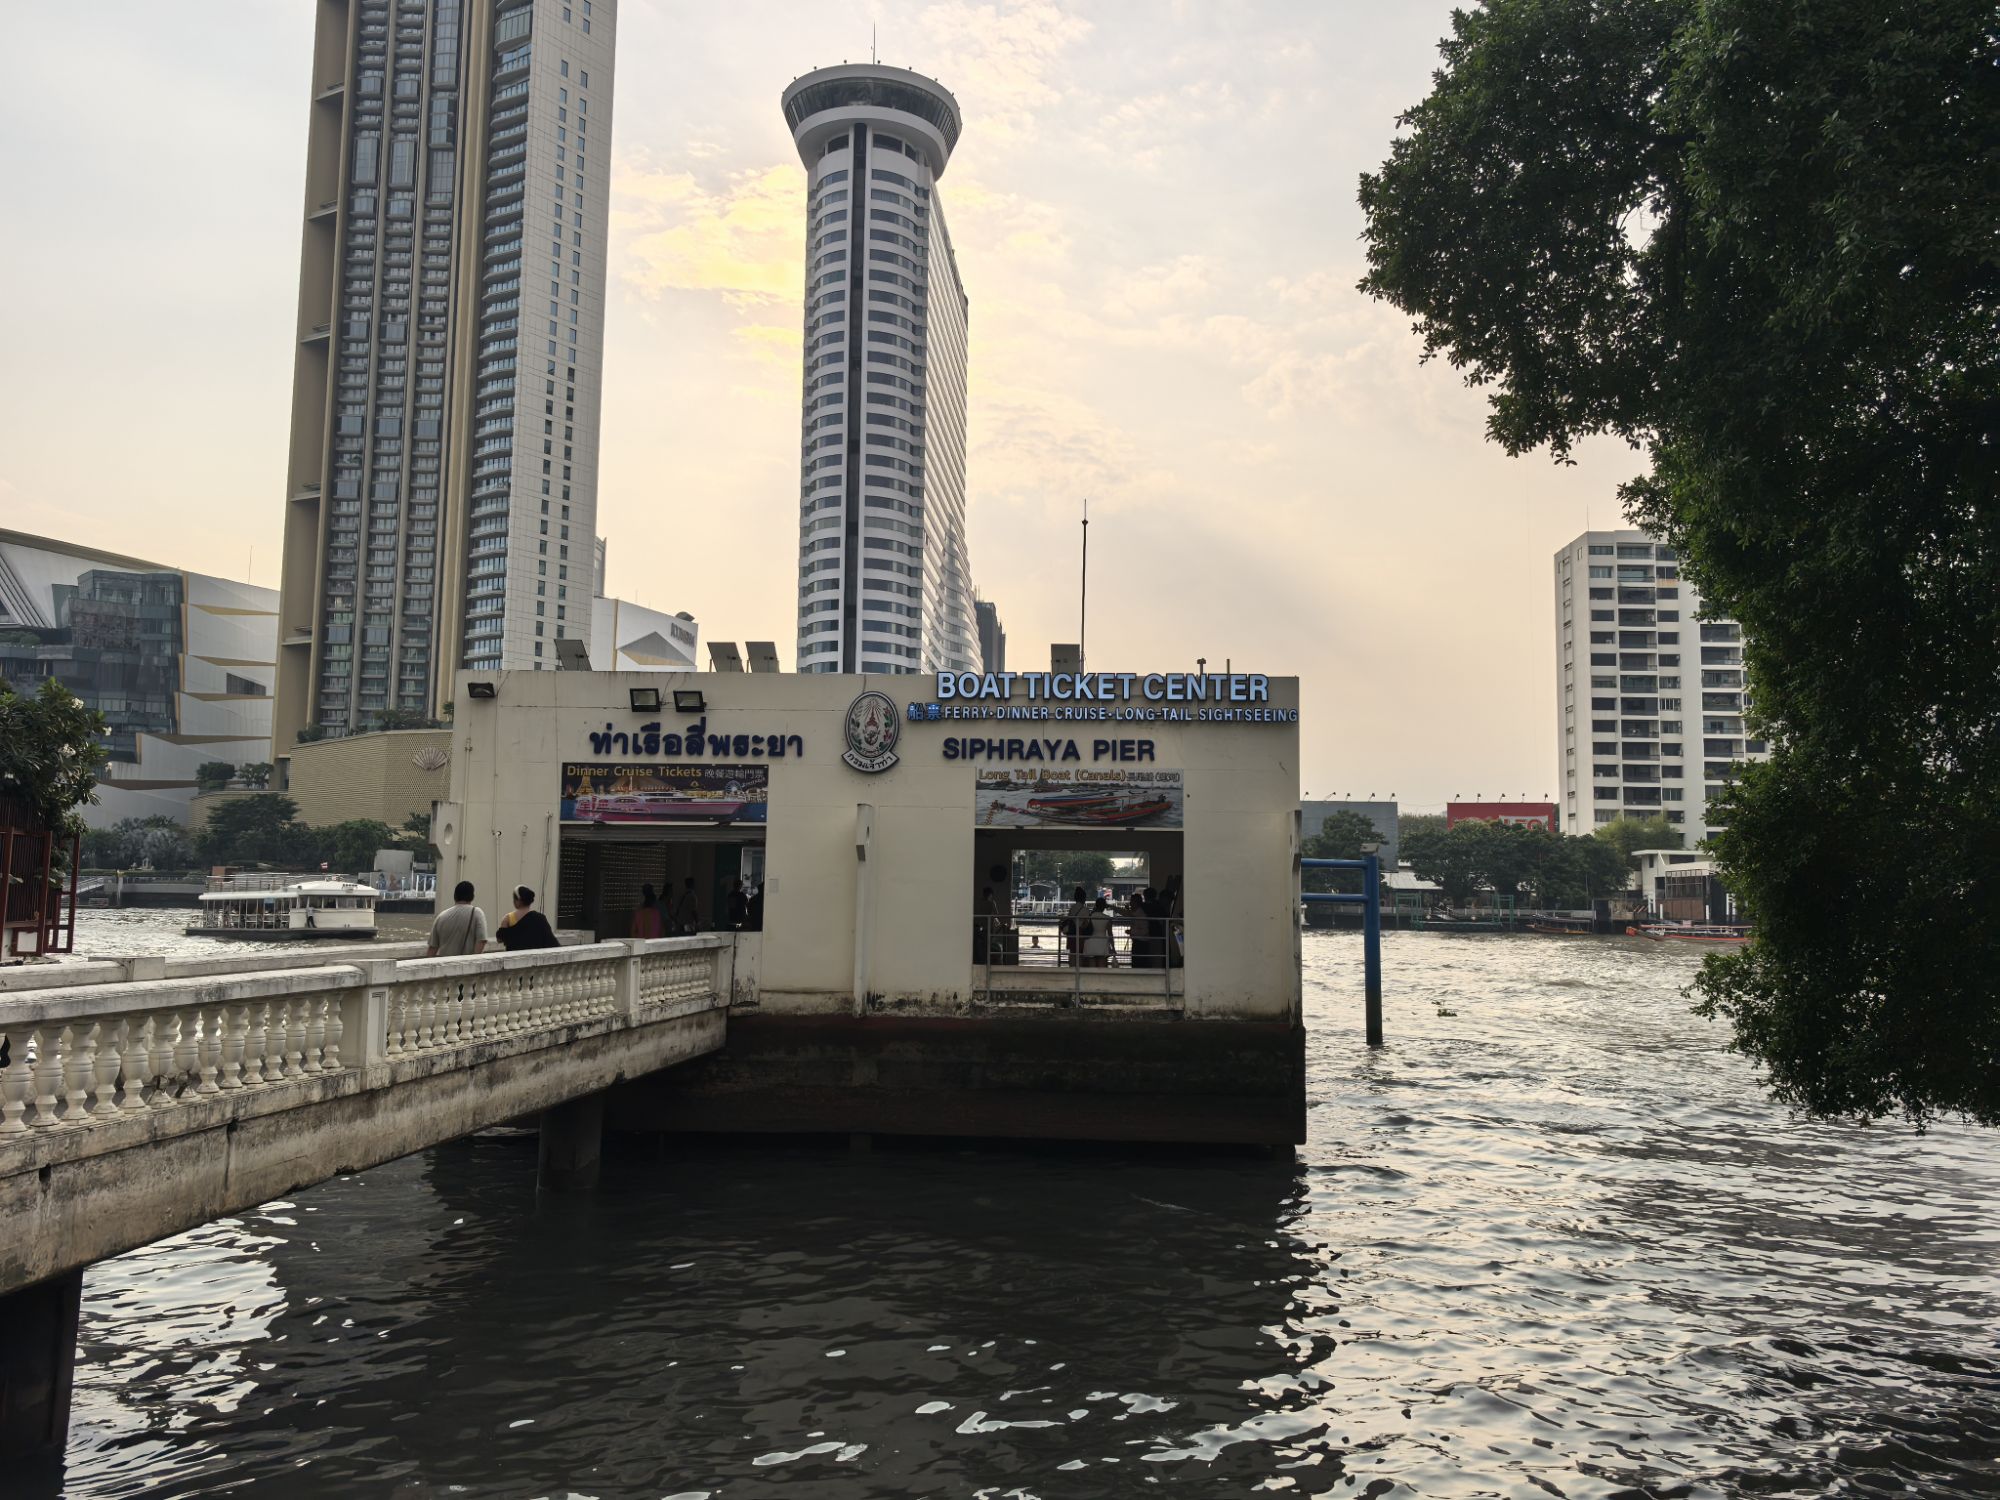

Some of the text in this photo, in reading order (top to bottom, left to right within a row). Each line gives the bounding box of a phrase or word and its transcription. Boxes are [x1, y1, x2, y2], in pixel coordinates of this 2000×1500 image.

[936, 671, 1270, 702] BOAT TICKET CENTER
[907, 702, 942, 721] 船票
[1199, 707, 1298, 722] SIGHTSEEING
[589, 716, 804, 757] ท่าเรือสี่พระยา
[942, 736, 1156, 762] SIPHRAYA PIER
[566, 765, 702, 778] Dinner Cruise Tickets
[978, 768, 1127, 782] Long Tail Boat (Canals)
